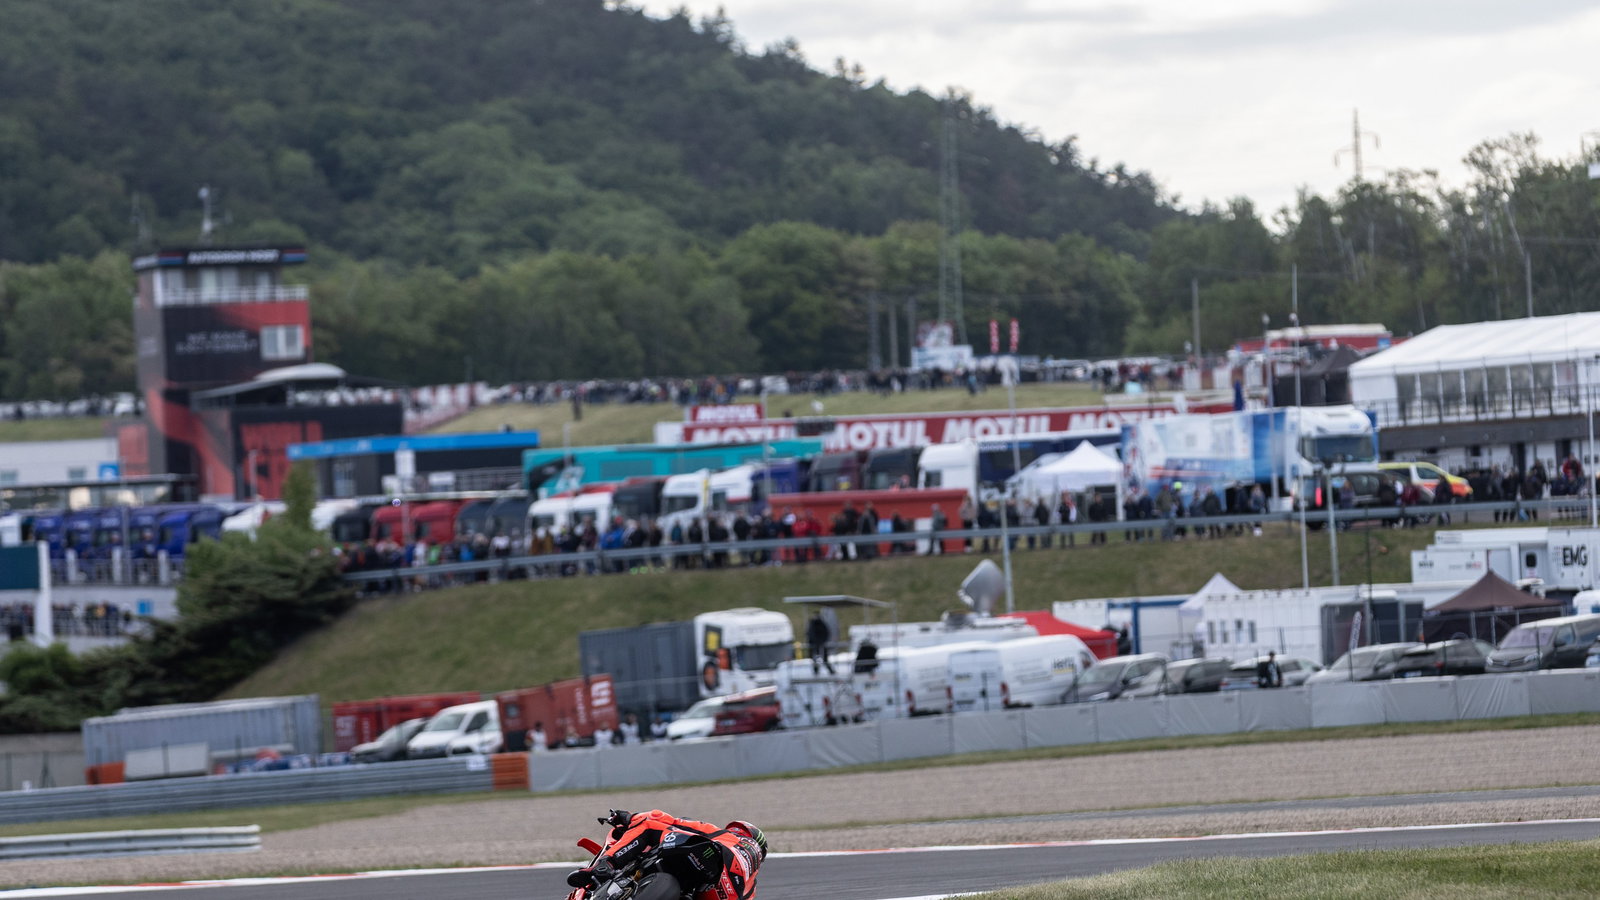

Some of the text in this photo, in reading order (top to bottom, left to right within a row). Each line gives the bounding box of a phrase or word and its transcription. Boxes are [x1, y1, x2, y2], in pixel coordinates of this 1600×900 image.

[697, 404, 759, 421] MOTUL
[825, 420, 932, 449] MOTUL
[1562, 546, 1588, 567] EMG
